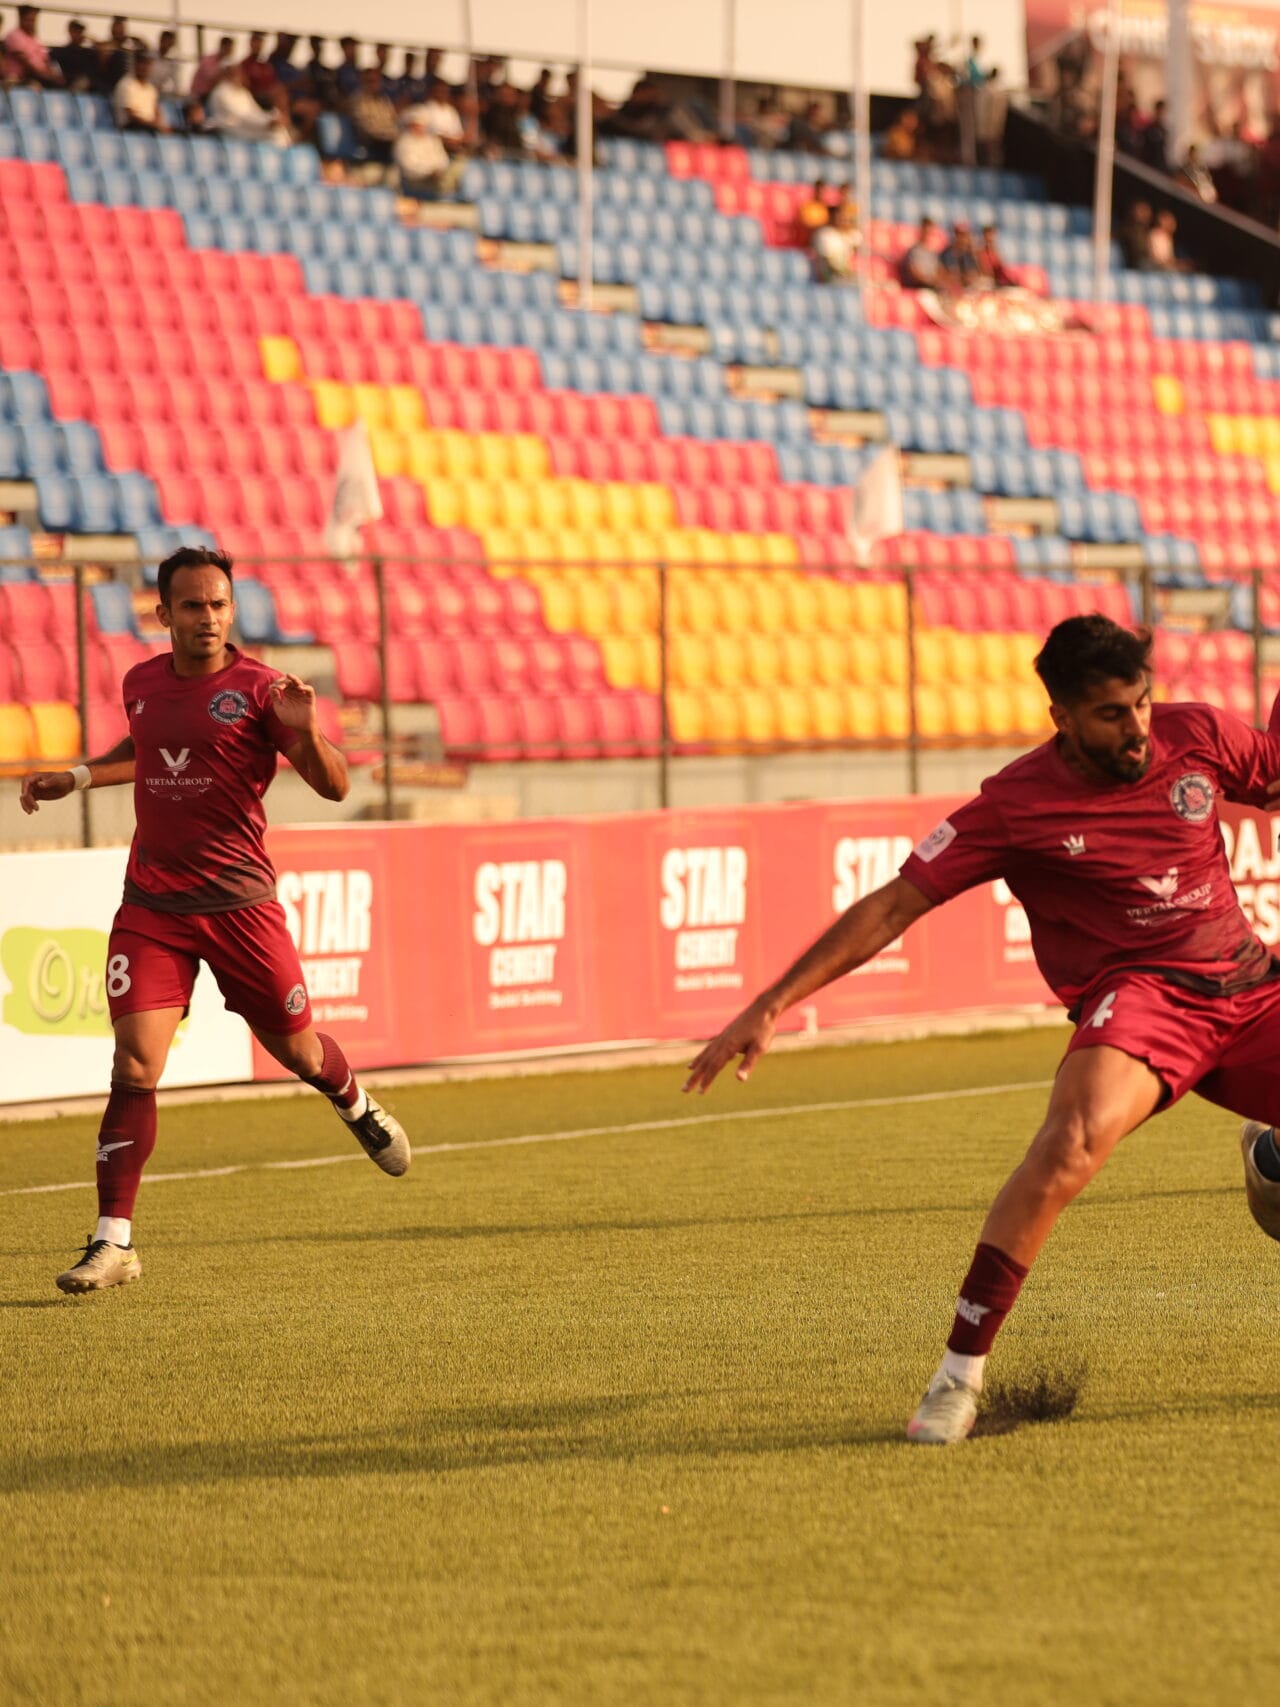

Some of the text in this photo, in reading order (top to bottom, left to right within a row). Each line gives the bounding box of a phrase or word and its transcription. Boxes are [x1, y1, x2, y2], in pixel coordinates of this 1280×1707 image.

[145, 777, 213, 787] VERTAK GROUP
[473, 859, 567, 947] STAR
[660, 846, 747, 931] STAR
[276, 869, 373, 955] STAR
[107, 954, 131, 998] 8
[300, 957, 363, 1000] EMENT
[1082, 991, 1117, 1028] 4
